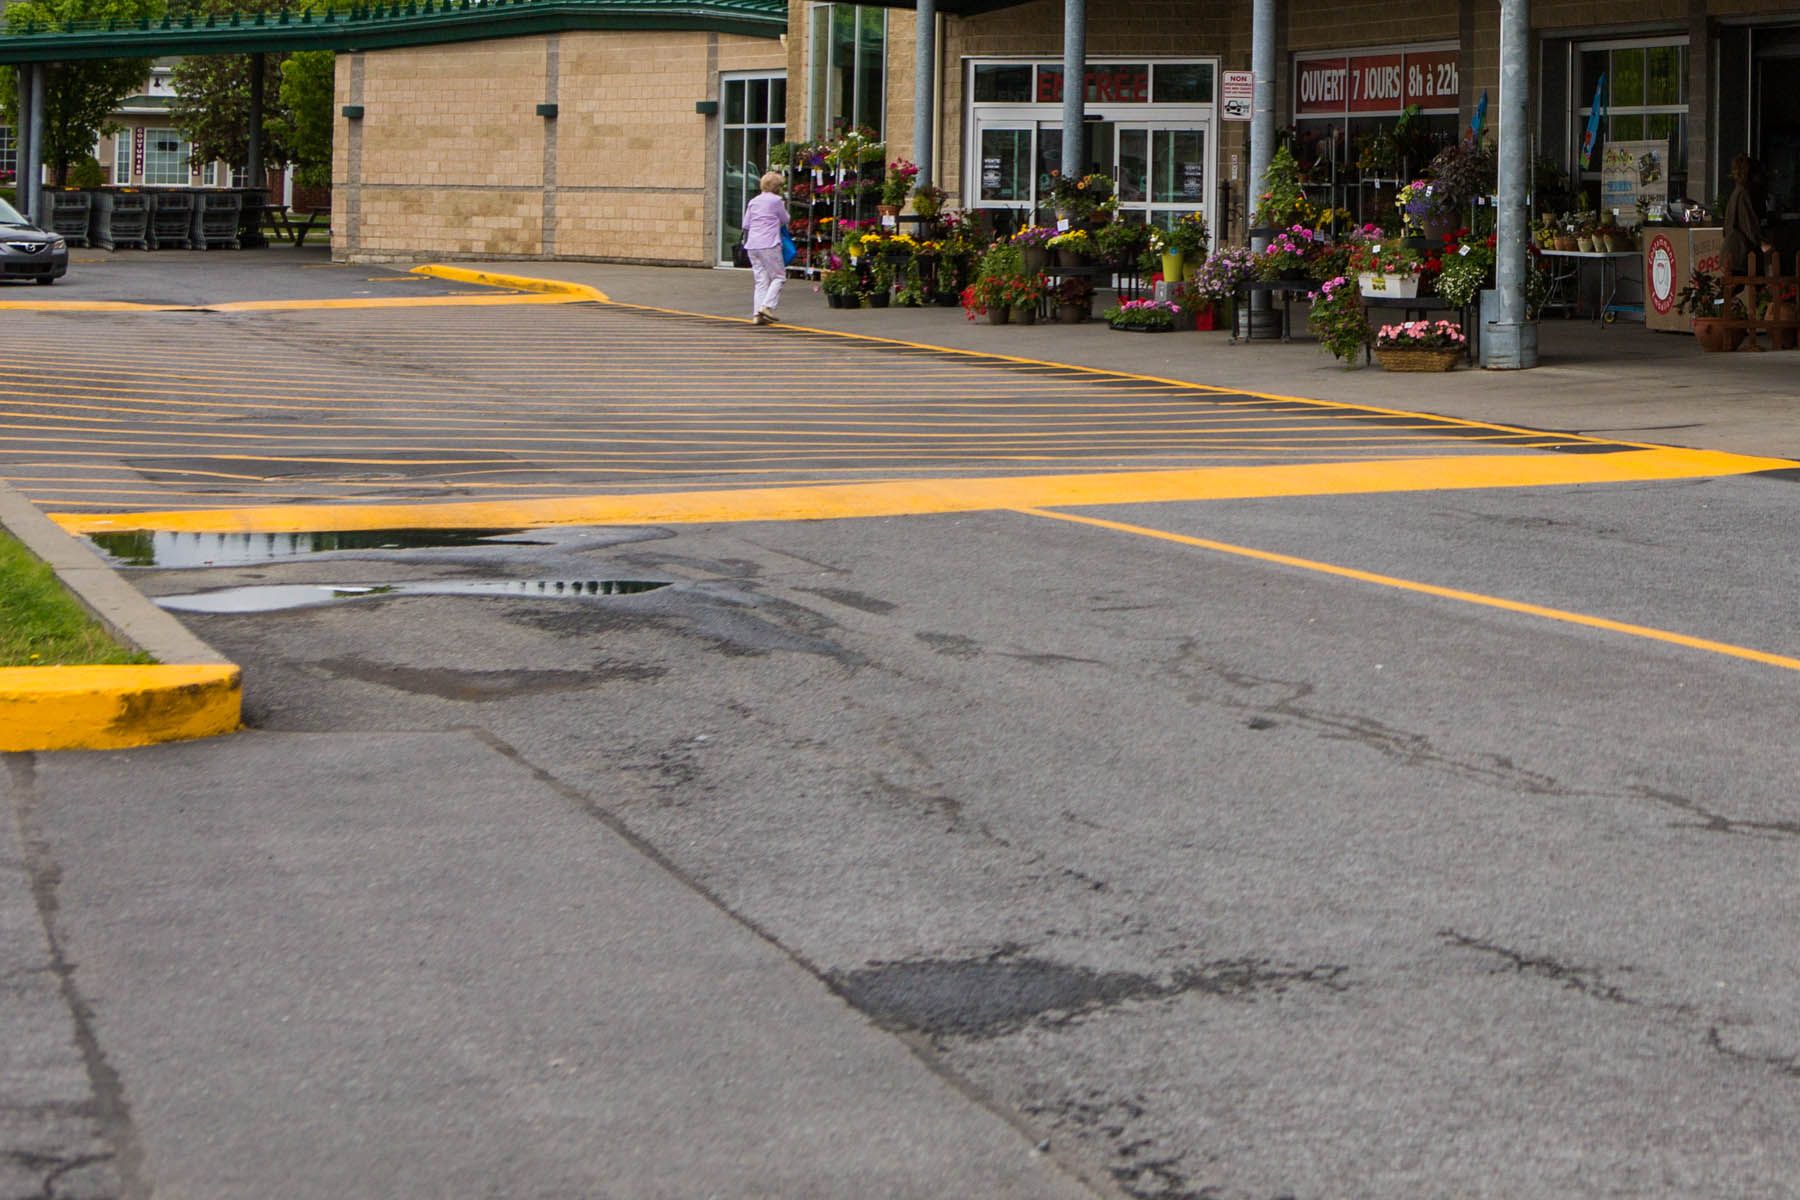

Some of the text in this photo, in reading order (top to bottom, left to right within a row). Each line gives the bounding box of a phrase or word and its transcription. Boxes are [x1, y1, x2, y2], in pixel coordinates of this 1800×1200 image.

[1301, 62, 1459, 102] OUVERT 7 JOURS 8h à 22h
